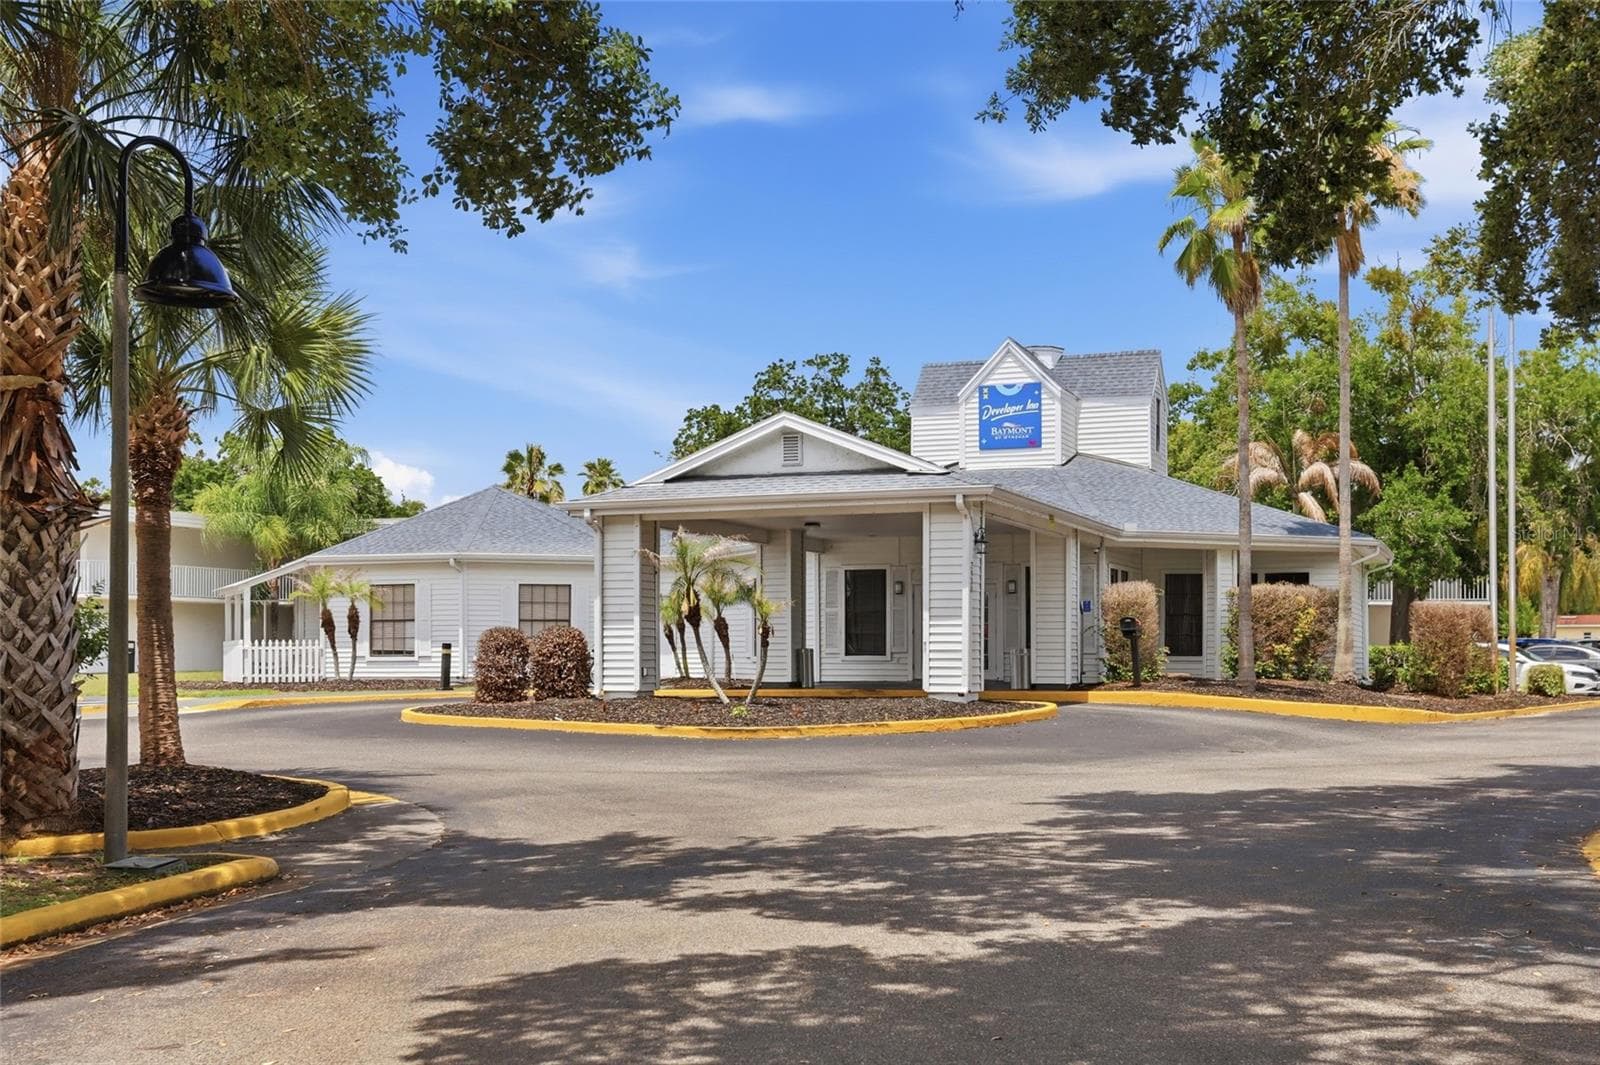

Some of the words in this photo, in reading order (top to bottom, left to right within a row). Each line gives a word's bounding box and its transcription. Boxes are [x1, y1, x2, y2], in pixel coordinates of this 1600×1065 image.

[982, 402, 1024, 420] Developer
[1026, 399, 1040, 410] Inn
[991, 426, 1035, 436] BAYMONT
